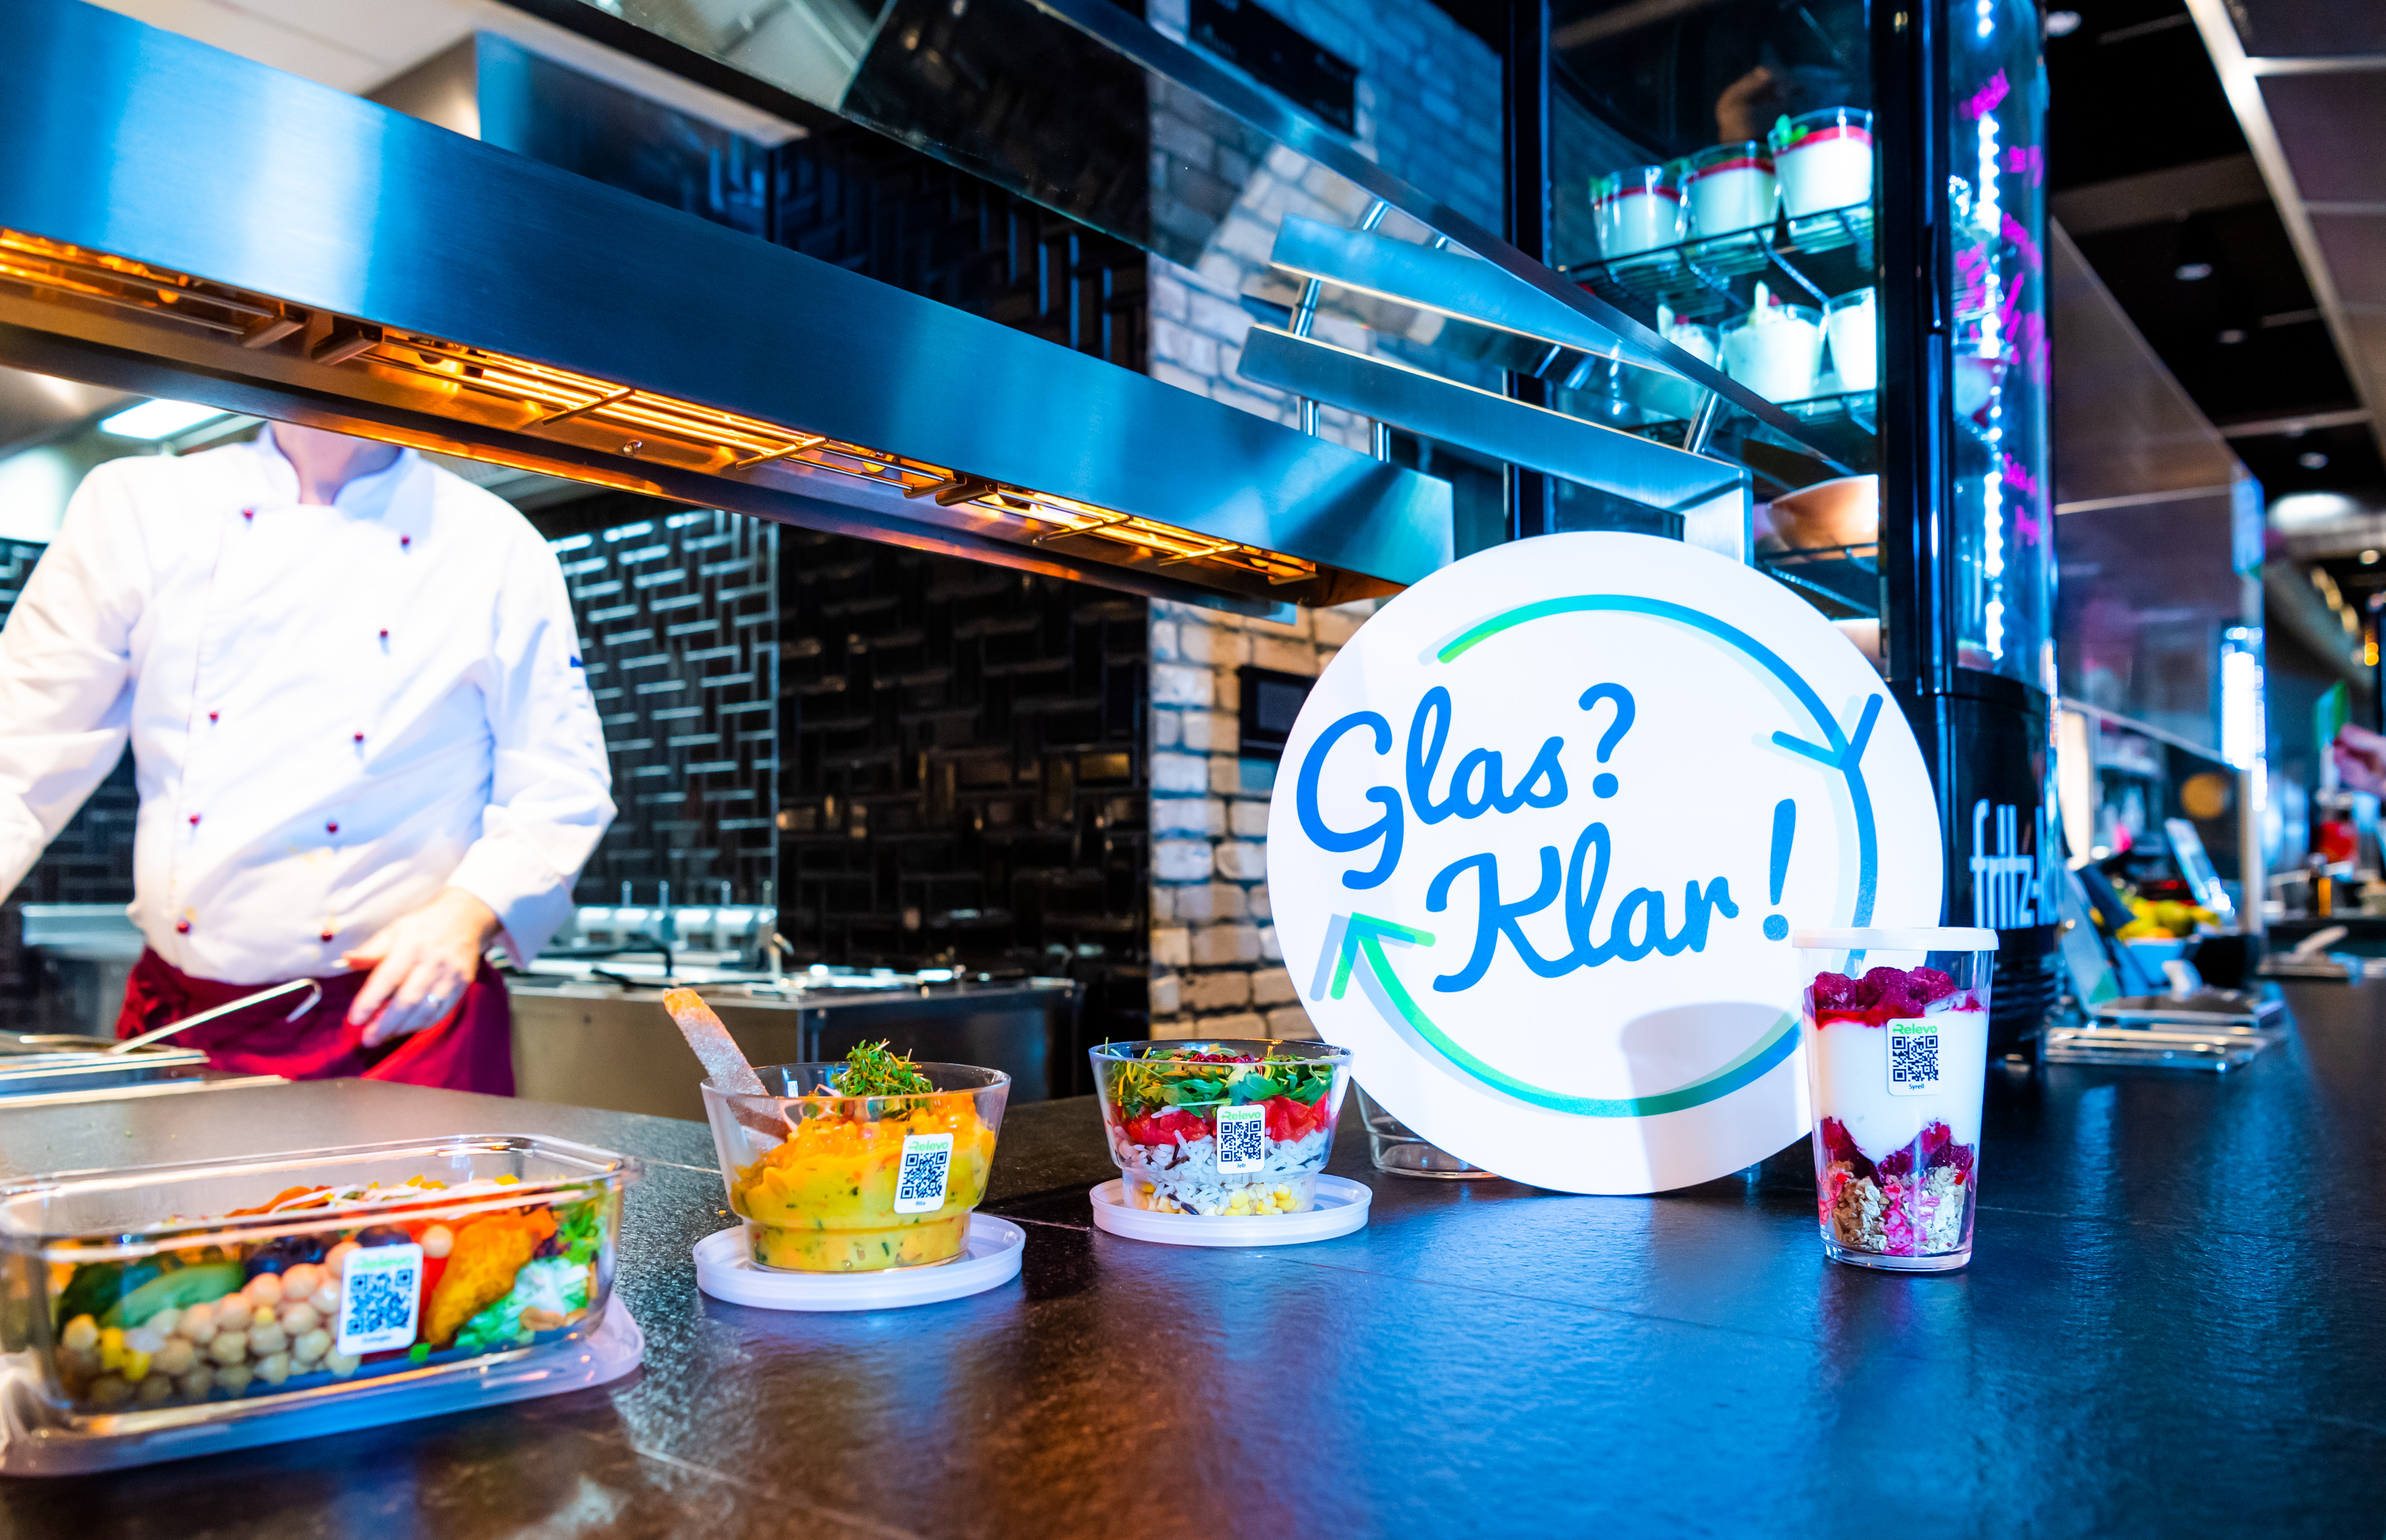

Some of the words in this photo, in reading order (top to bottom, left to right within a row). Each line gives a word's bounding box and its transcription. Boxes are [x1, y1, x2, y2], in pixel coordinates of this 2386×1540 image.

[1297, 683, 1635, 890] Glas?
[1893, 1023, 1937, 1034] Relevo
[1221, 1111, 1261, 1120] Relevo
[909, 1140, 948, 1150] Relevo
